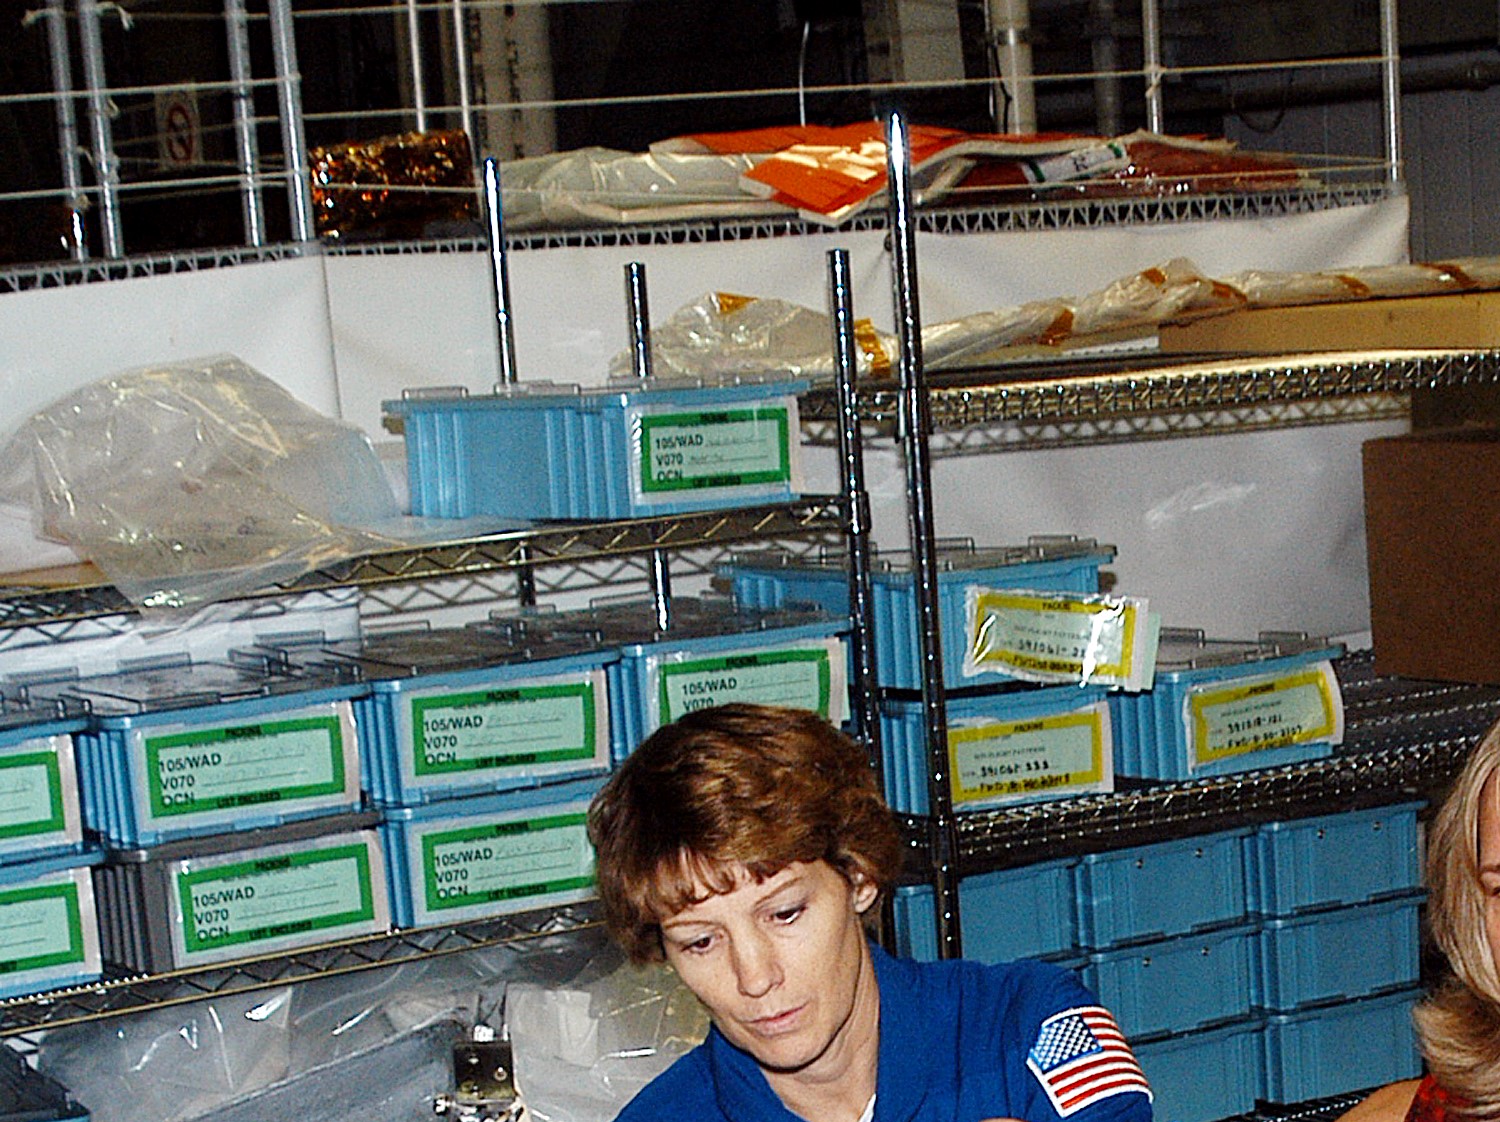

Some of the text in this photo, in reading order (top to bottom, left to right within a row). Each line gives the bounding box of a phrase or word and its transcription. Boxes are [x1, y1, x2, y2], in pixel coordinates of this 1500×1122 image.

[655, 435, 703, 450] 105/WAD
[656, 455, 683, 466] V070
[682, 677, 737, 695] 105/WAD
[424, 715, 482, 732] 105/WAD
[424, 735, 457, 749] V070
[159, 753, 221, 773] 105/WAD
[161, 775, 195, 790] V070
[435, 848, 493, 867] 105/WAD
[435, 868, 468, 883] V070
[194, 886, 254, 908] 105/WAD
[194, 908, 229, 925] V070
